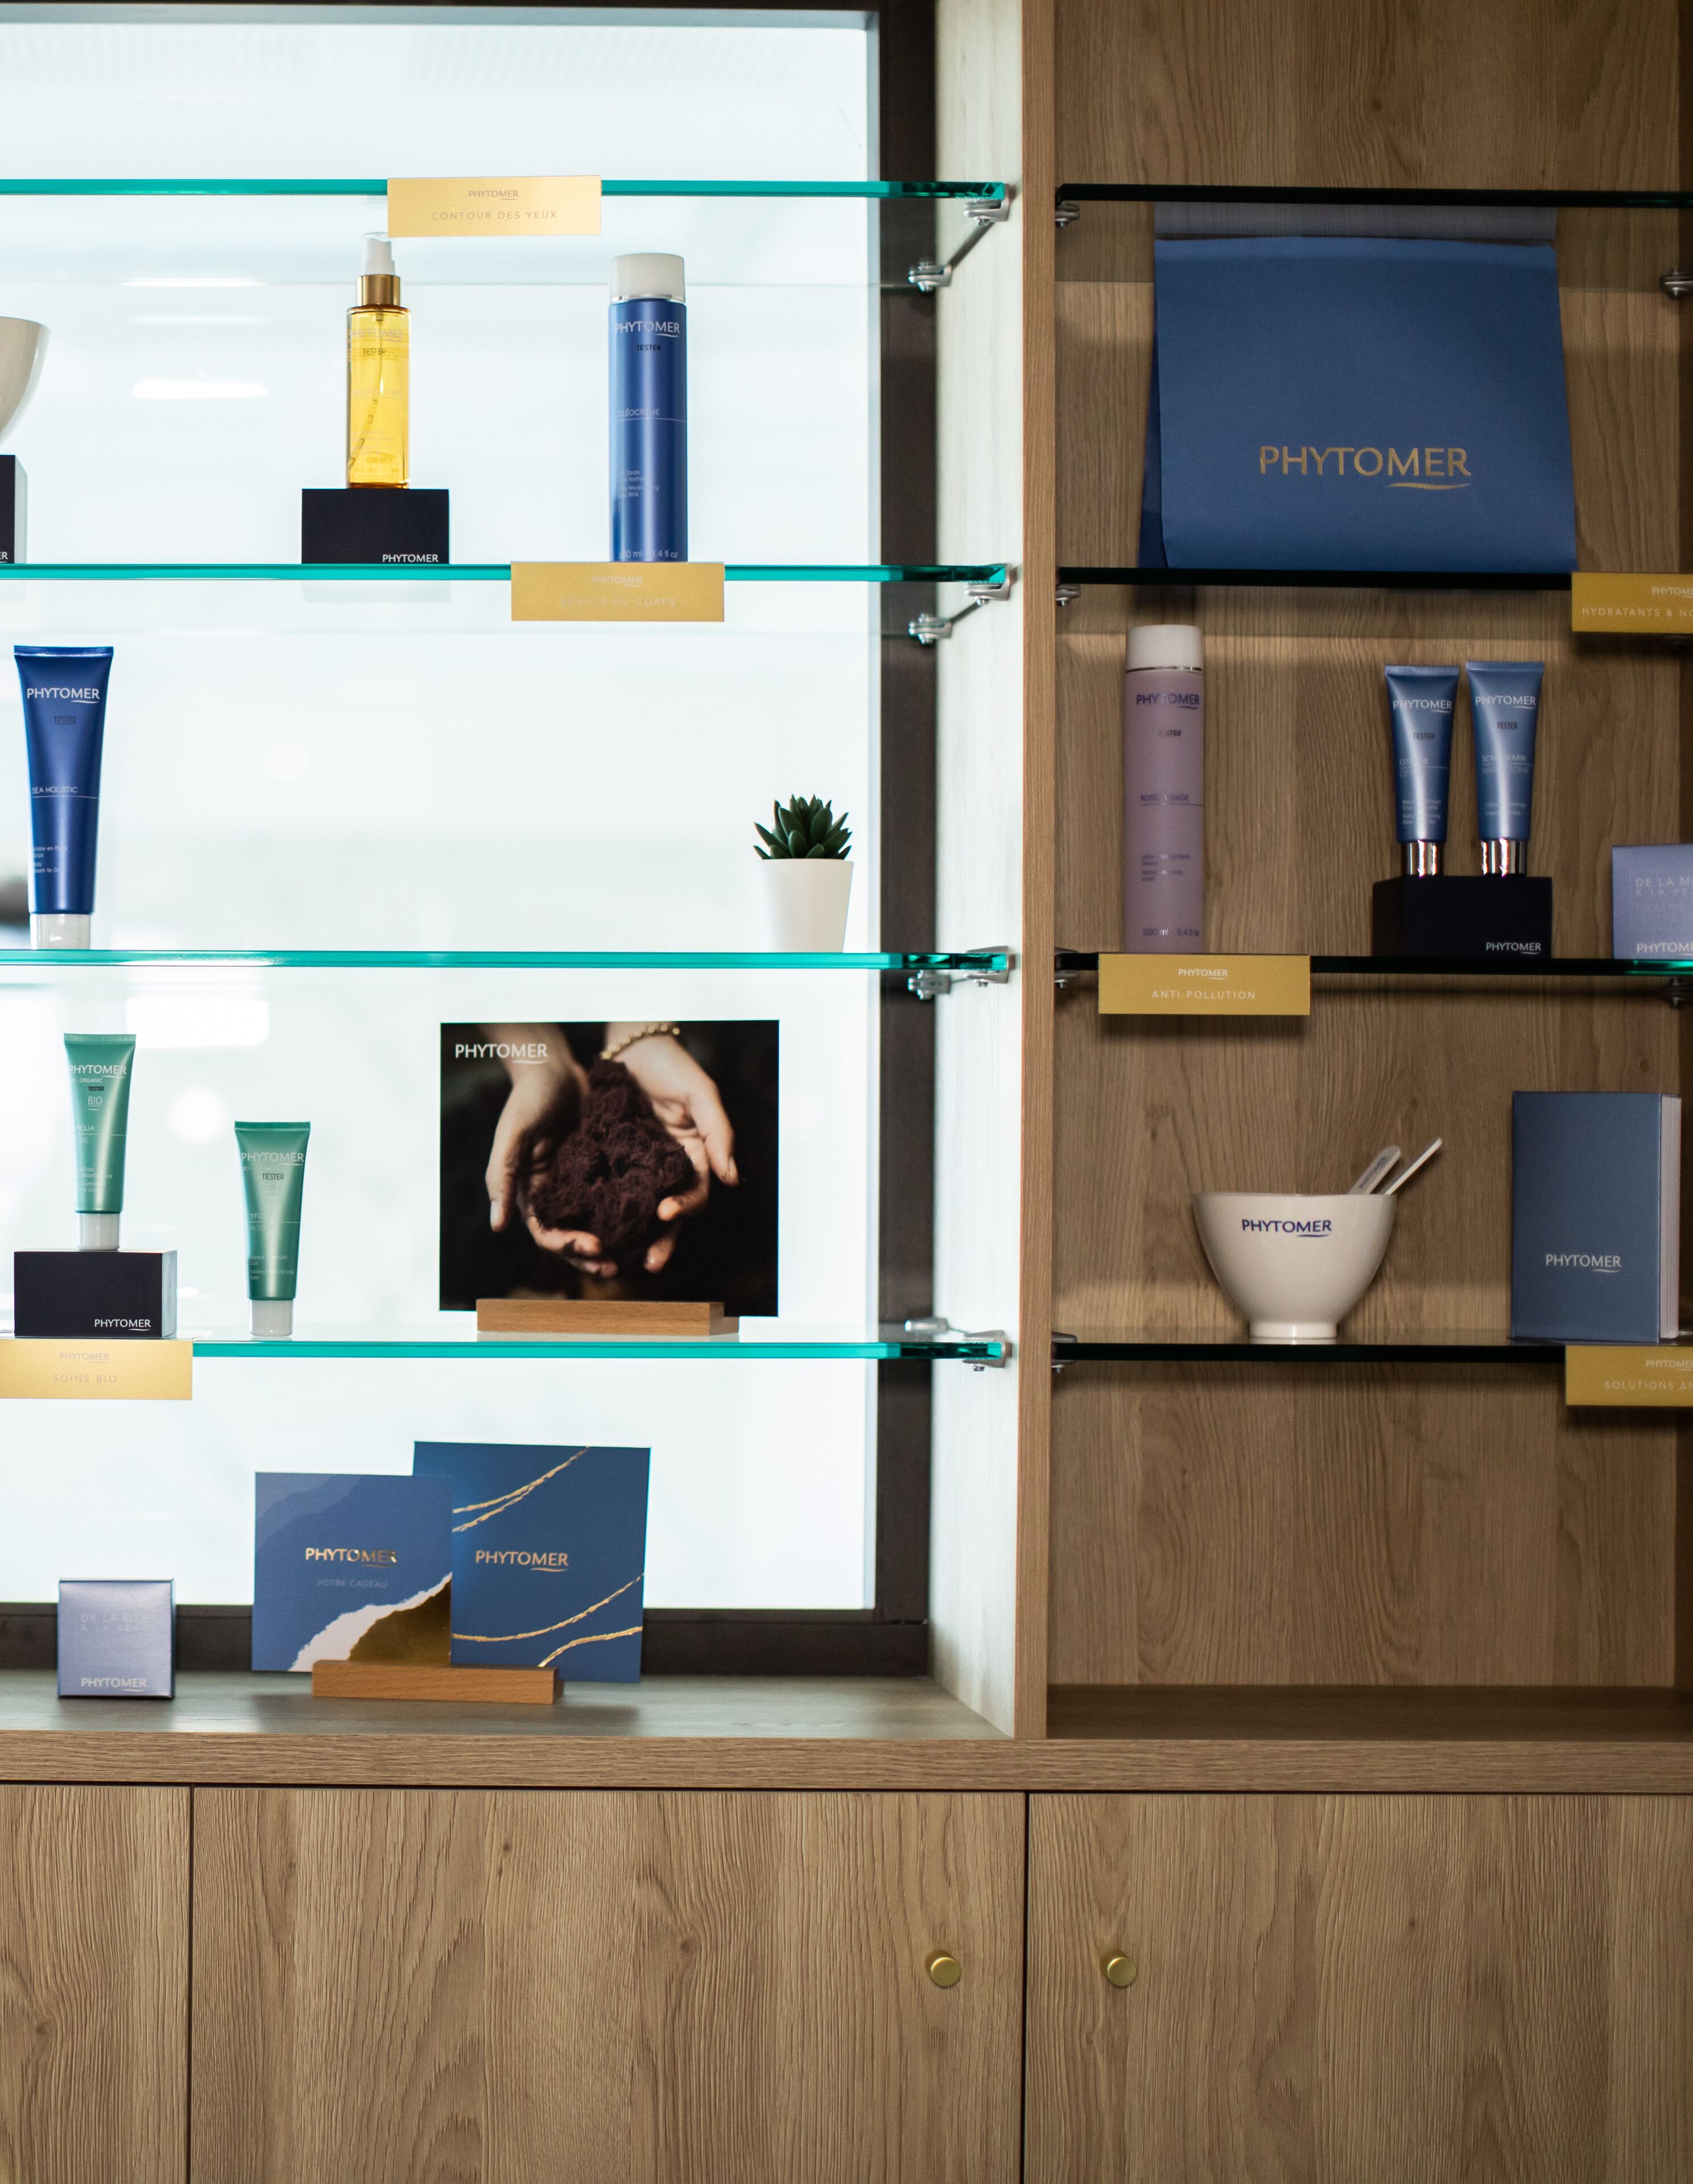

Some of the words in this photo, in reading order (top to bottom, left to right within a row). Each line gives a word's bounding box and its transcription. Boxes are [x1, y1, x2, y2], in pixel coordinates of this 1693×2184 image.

[431, 212, 492, 221] CONTOUR
[498, 211, 521, 220] DES
[526, 210, 557, 220] YEUX
[615, 321, 680, 334] PHYTOMER
[1260, 445, 1472, 477] PHYTOMER
[382, 554, 439, 563] PHYTOMER
[635, 597, 675, 607] CORPS
[1582, 607, 1661, 617] HYDRATANTS
[27, 687, 101, 700] PHYTOMER
[1136, 693, 1199, 706] PHYTOMER
[1393, 699, 1452, 710] PHYTOMER
[1475, 695, 1536, 706] PHYTOMER
[54, 715, 77, 725] TESTER
[1486, 942, 1542, 952] PHYTOMER
[1178, 969, 1228, 977] PHYTOMER
[1151, 990, 1256, 1000] ANTI-POLLUTION
[455, 1044, 547, 1058] PHYTOMER
[88, 1096, 102, 1105] BIO
[241, 1152, 304, 1162] PHYTOMER
[1241, 1219, 1332, 1233] PHYTOMER
[1545, 1254, 1621, 1268] PHYTOMER
[94, 1318, 151, 1327] PHYTOMER
[59, 1352, 110, 1360] PHYTOMER
[53, 1374, 90, 1383] SOINS
[96, 1374, 117, 1383] BIO
[1604, 1381, 1674, 1390] SOLUTIONS
[305, 1547, 398, 1563] PHYTOMER
[475, 1549, 568, 1566] PHYTOMER
[318, 1578, 346, 1587] VOTRE
[350, 1579, 388, 1588] CADEAU
[81, 1678, 147, 1688] PHYTOMER
